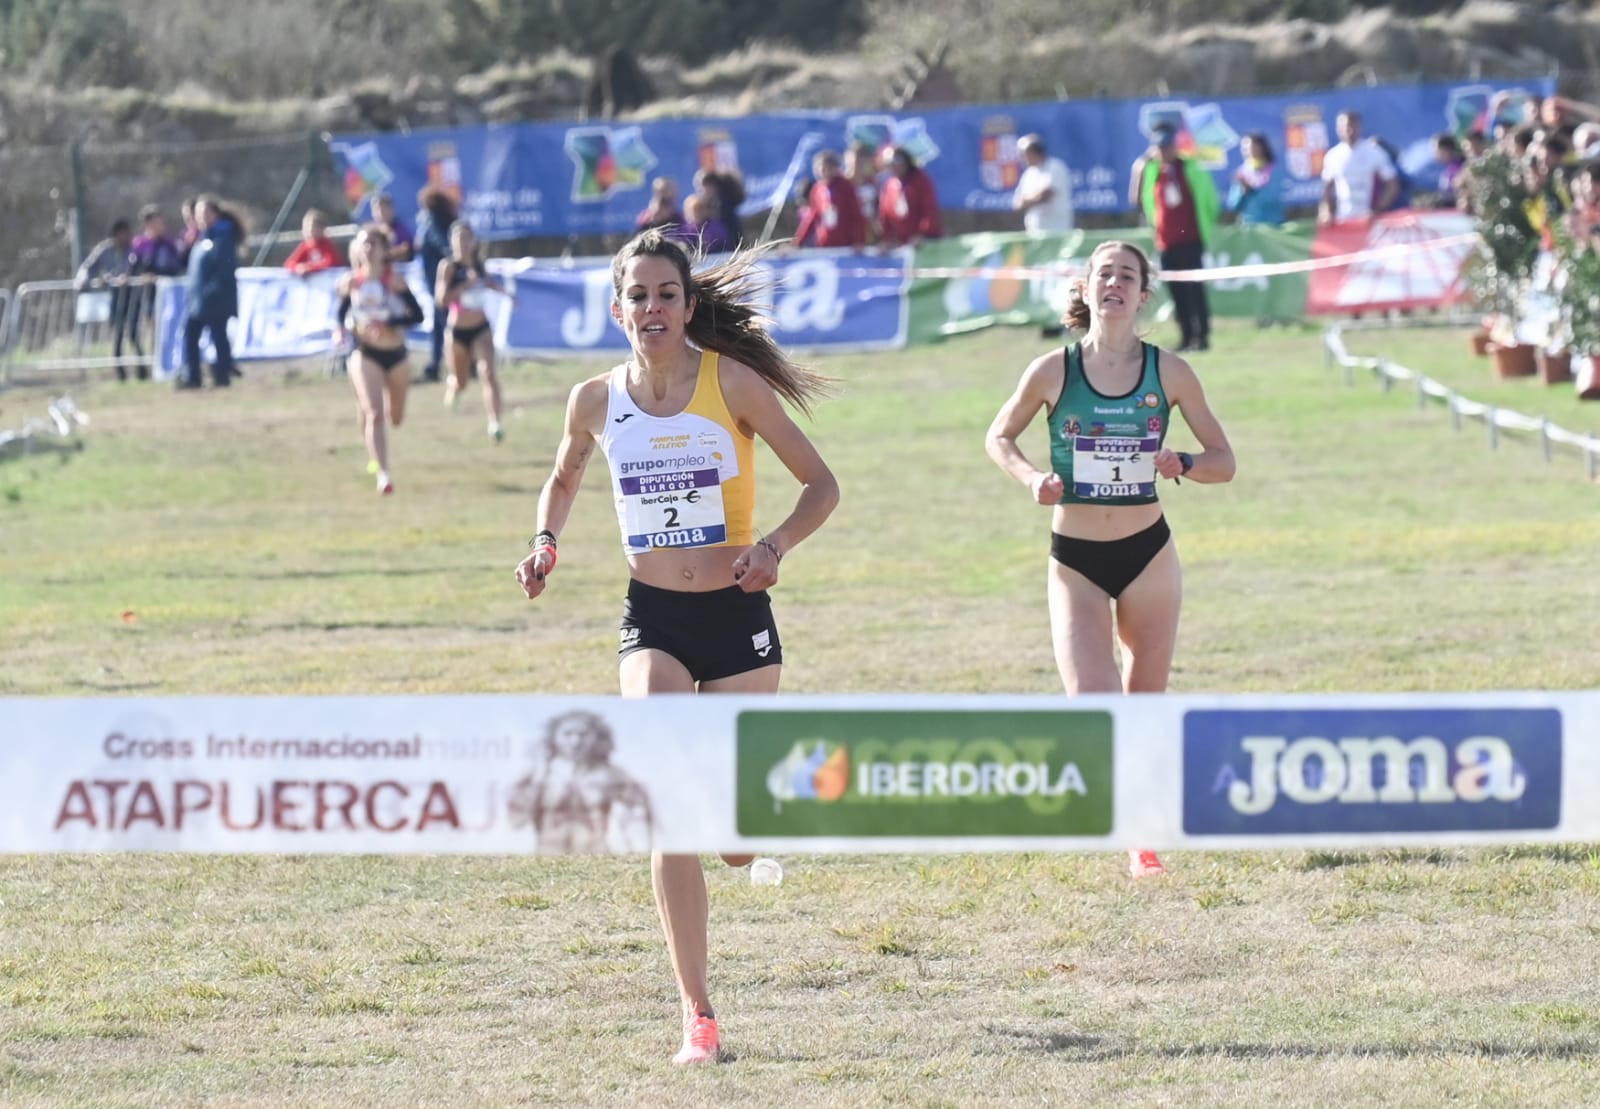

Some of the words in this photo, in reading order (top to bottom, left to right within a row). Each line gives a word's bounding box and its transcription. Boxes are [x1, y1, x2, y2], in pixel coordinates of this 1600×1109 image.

[621, 454, 705, 474] grupompleo
[1112, 466, 1123, 482] 1
[640, 472, 694, 485] DIPUTACIÓN
[641, 481, 695, 493] BURGOS
[641, 494, 679, 505] iberCaja
[664, 507, 680, 528] 2
[104, 733, 193, 759] Cross
[207, 733, 421, 759] Internacional
[858, 762, 1087, 796] IBERDROLA
[54, 779, 461, 832] ATAPUERCA
